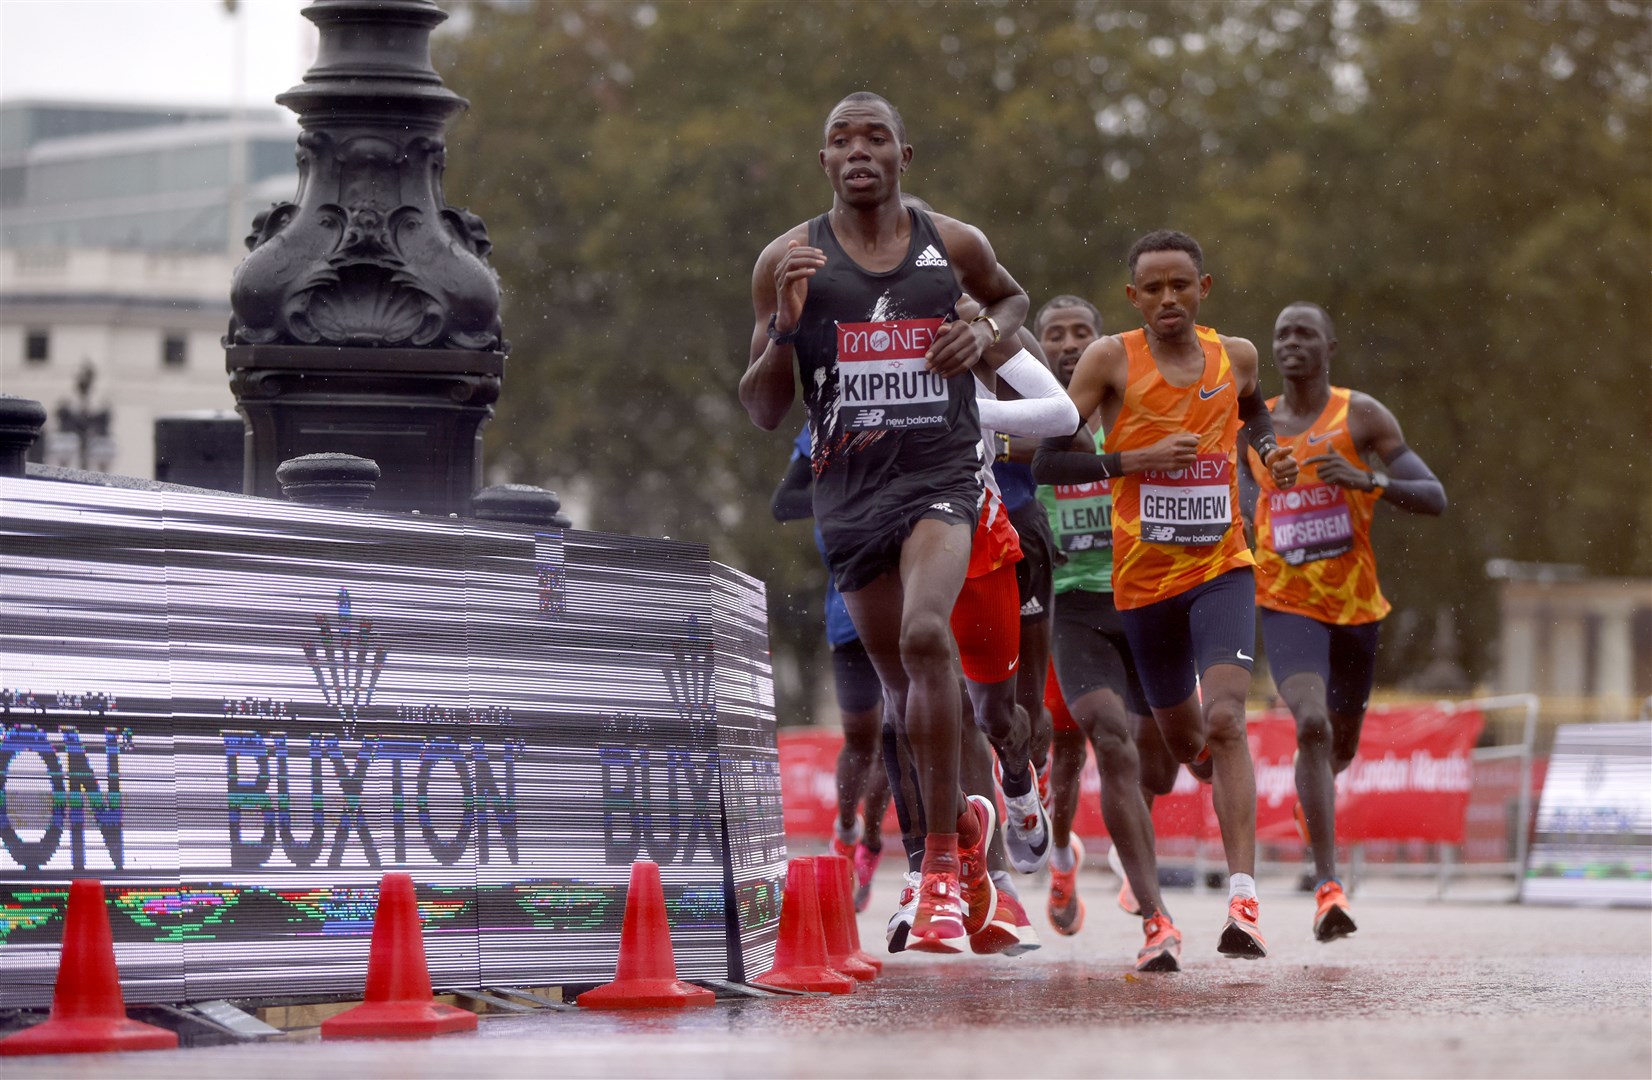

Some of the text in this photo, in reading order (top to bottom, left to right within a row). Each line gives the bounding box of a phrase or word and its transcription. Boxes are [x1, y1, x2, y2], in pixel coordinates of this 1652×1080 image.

[915, 257, 948, 267] adidas
[844, 371, 944, 402] KIPRUTO
[886, 415, 943, 427] new balance
[1143, 495, 1227, 521] GEREMEW
[1270, 484, 1340, 512] MONEY
[1273, 513, 1350, 549] KIPSEREM
[219, 729, 519, 868] BUXTON
